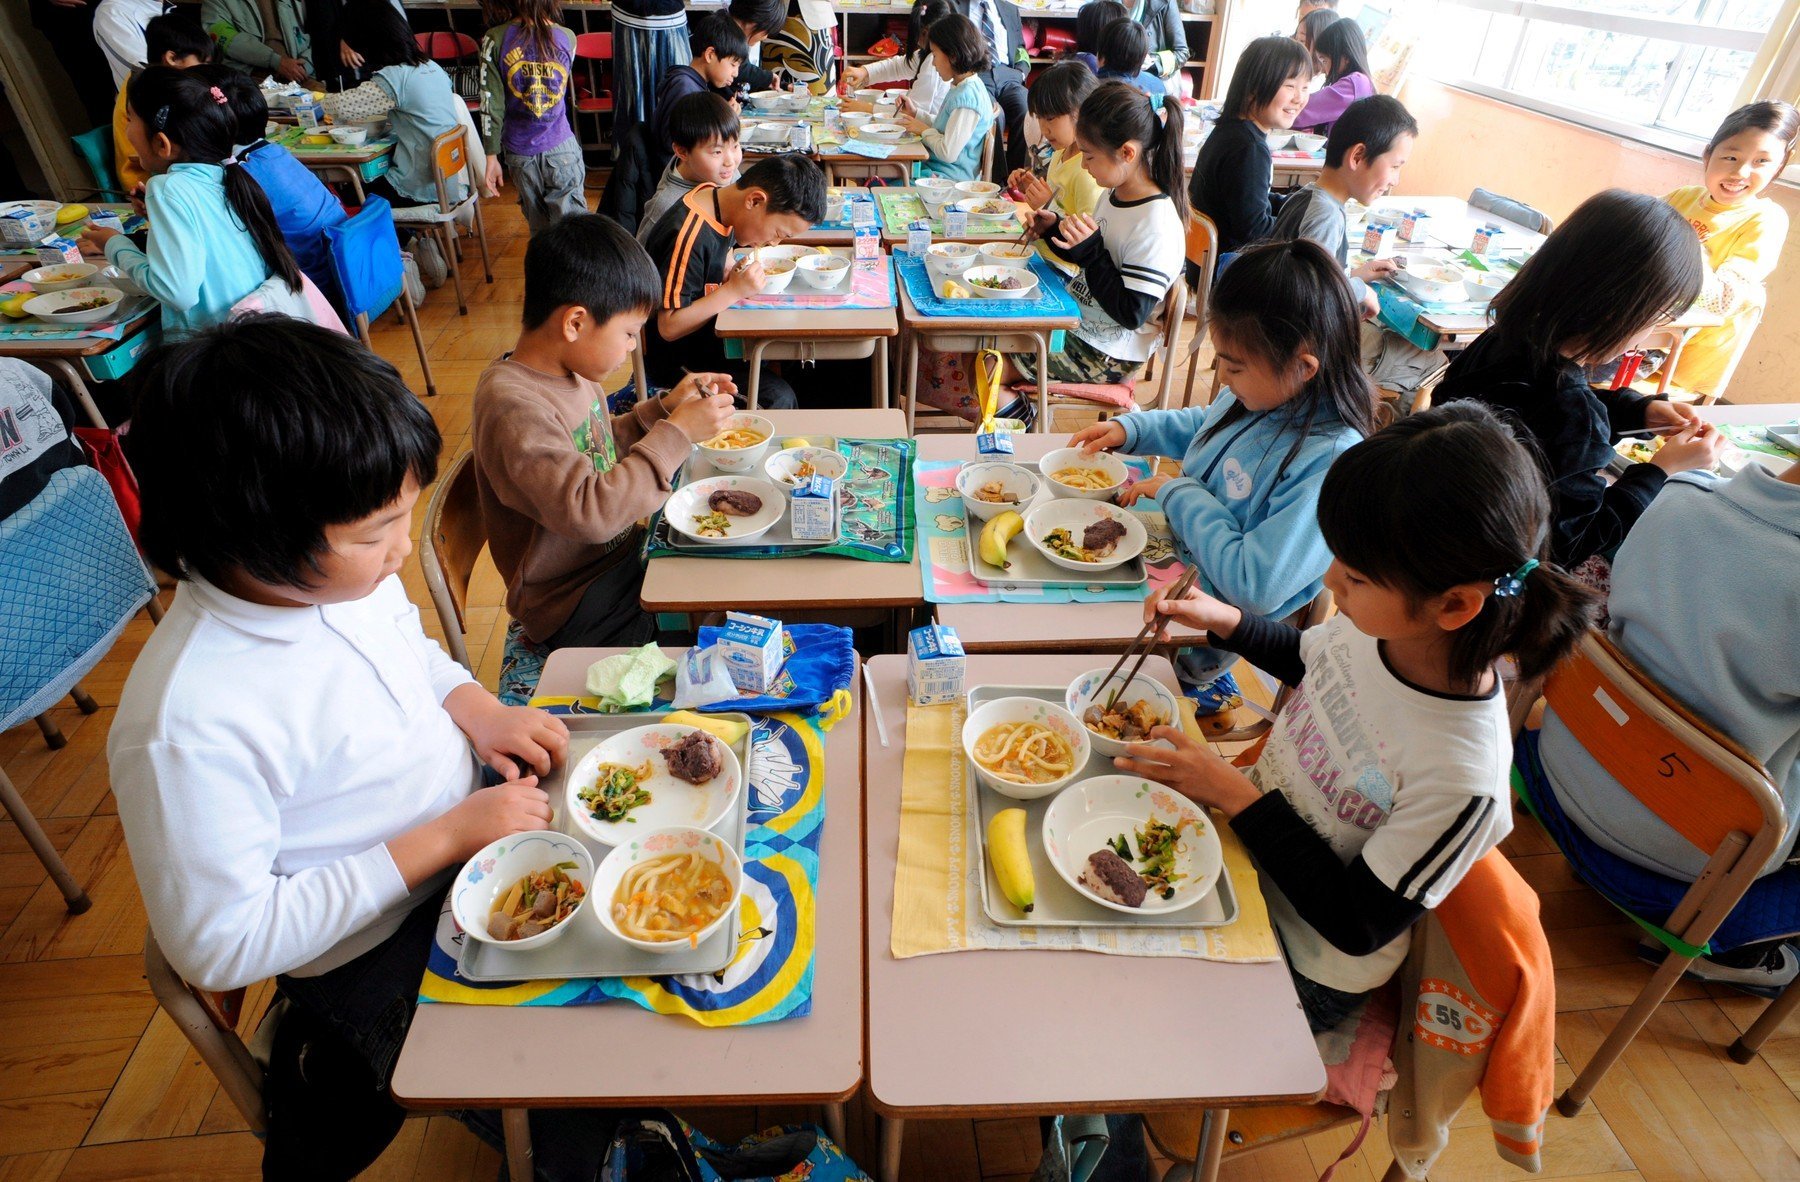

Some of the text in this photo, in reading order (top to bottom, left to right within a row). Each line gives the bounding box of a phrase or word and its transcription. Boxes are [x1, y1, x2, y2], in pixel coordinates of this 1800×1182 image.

[729, 622, 765, 637] コーシン牛乳
[1657, 752, 1691, 778] 5
[1436, 1004, 1462, 1031] 55
